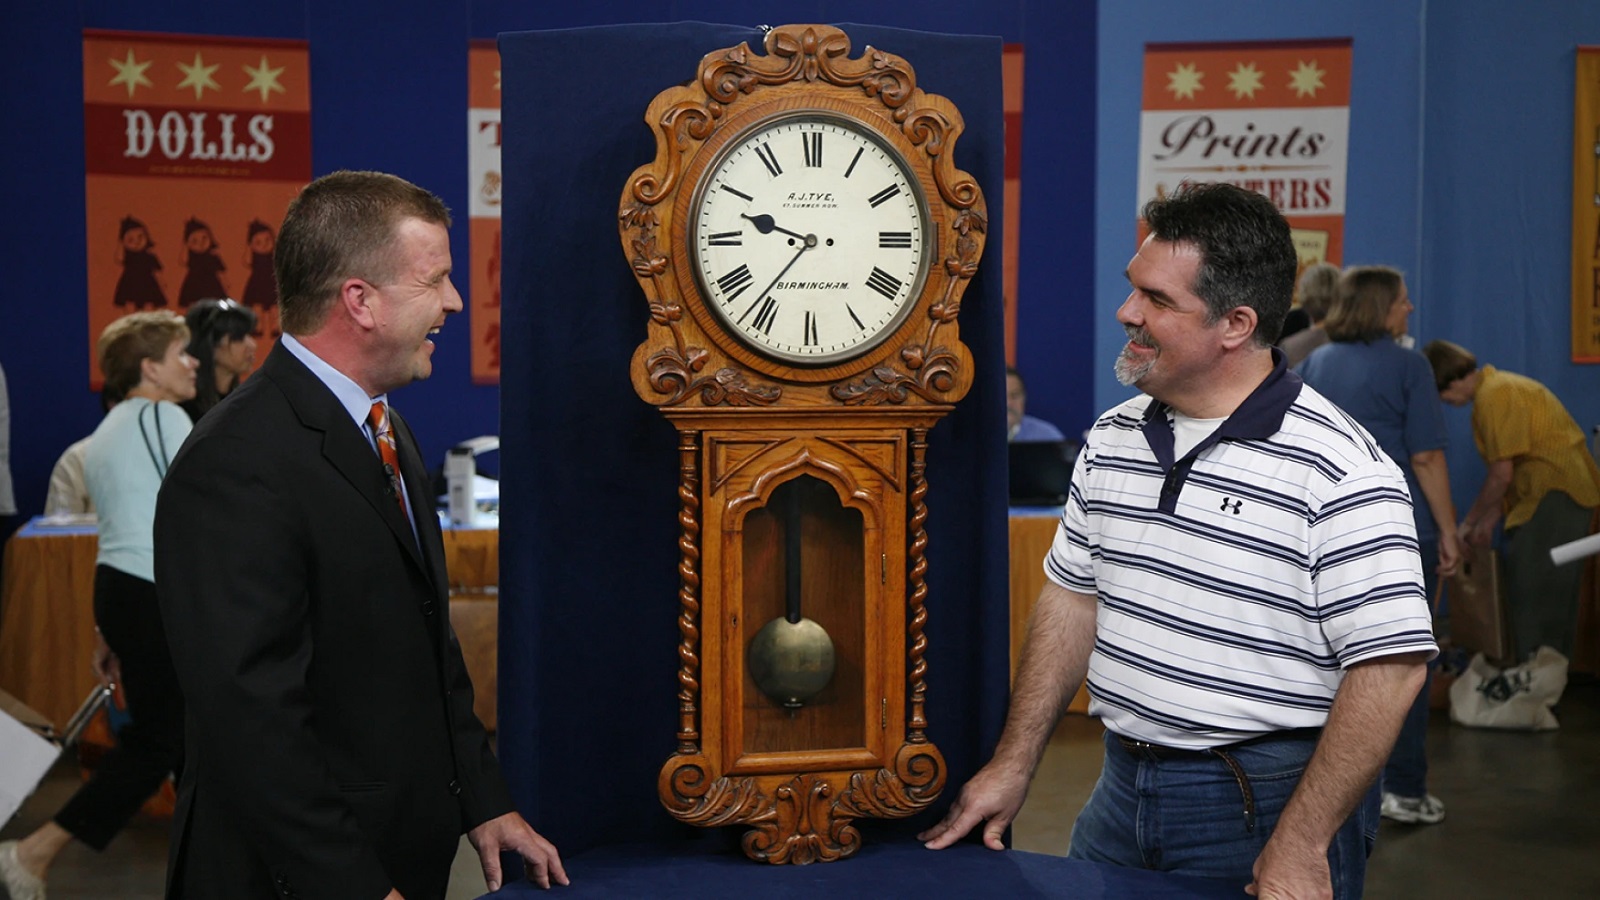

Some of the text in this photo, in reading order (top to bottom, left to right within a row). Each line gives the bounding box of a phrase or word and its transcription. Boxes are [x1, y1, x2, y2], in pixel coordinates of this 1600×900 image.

[123, 109, 274, 162] DOLLS
[802, 132, 822, 168] XII
[1153, 115, 1326, 160] Prints
[868, 183, 901, 208] II
[879, 232, 911, 248] III
[717, 264, 755, 303] VIII
[865, 266, 902, 301] IIII
